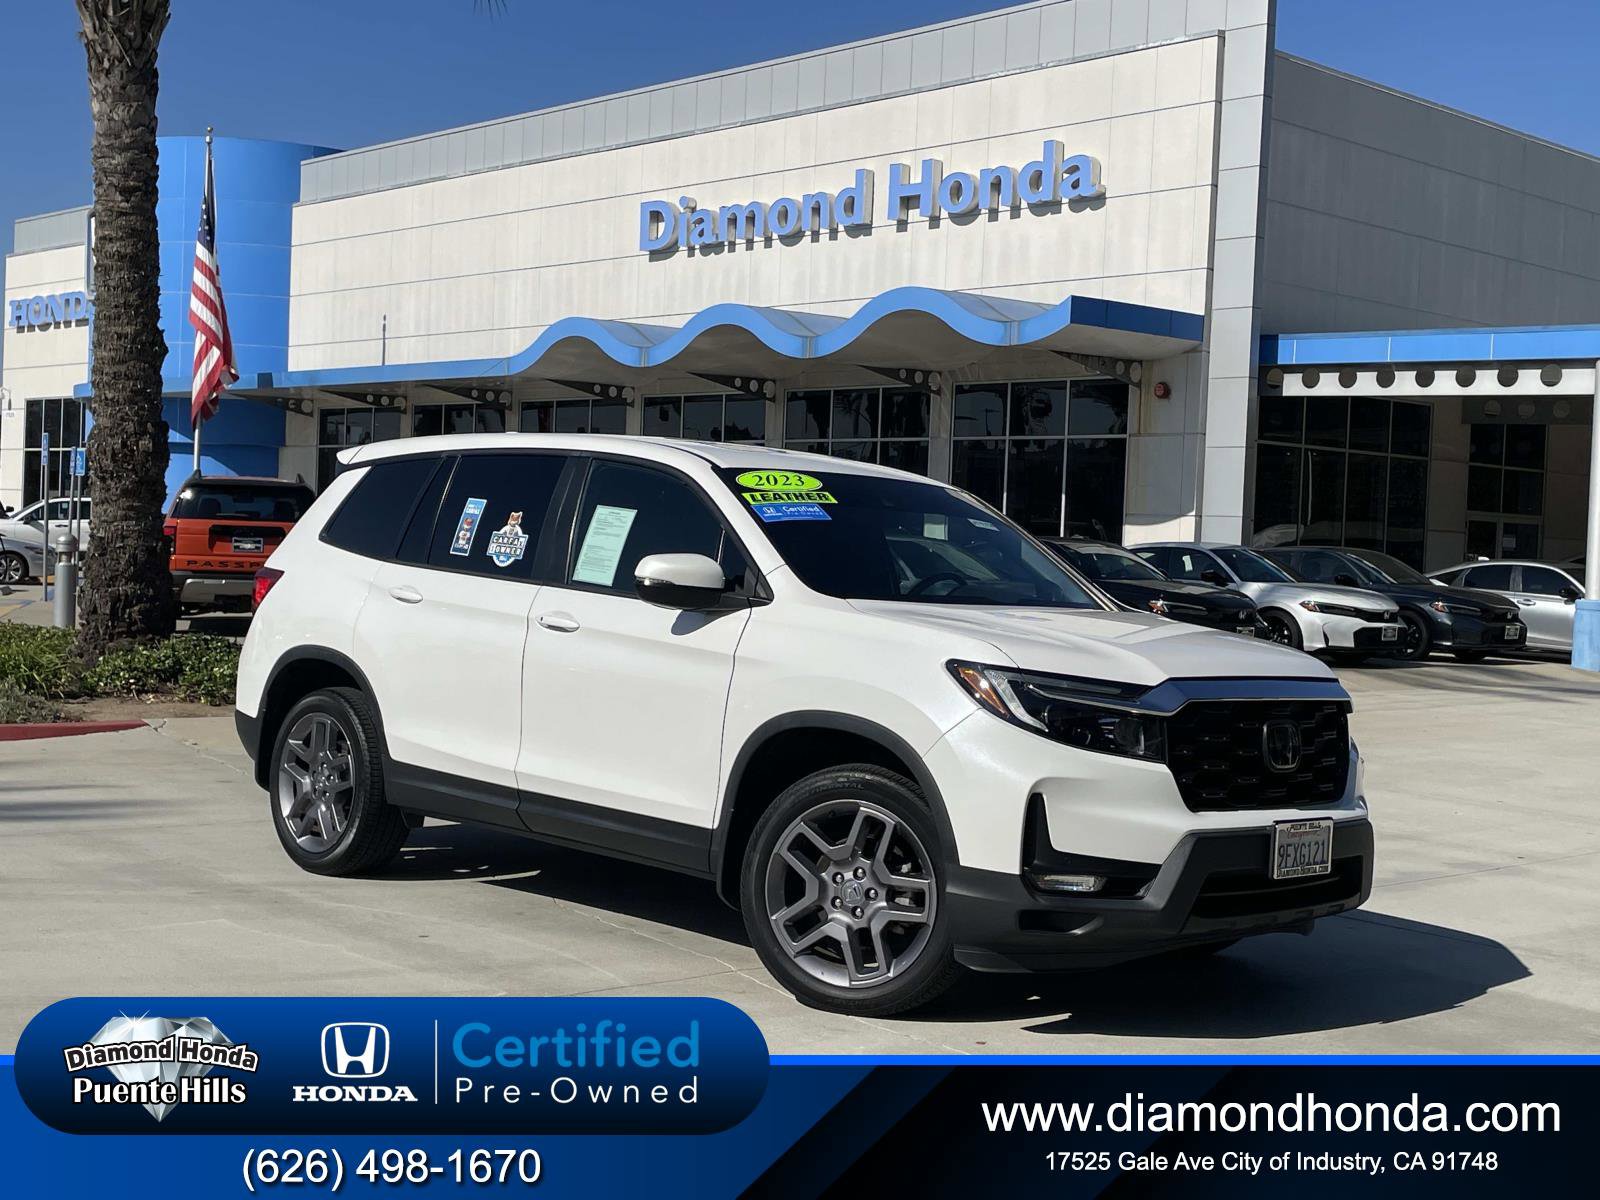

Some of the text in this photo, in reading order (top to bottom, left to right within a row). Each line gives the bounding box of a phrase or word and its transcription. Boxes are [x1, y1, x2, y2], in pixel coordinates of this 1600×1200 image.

[640, 139, 1105, 252] Diamond Honda
[9, 291, 87, 326] HOND
[752, 474, 805, 487] 2023
[749, 493, 829, 502] LEATHER
[493, 536, 525, 547] CARFAX
[495, 545, 521, 556] OWNER
[186, 560, 261, 568] PASSP
[1278, 840, 1326, 868] 9FXG121
